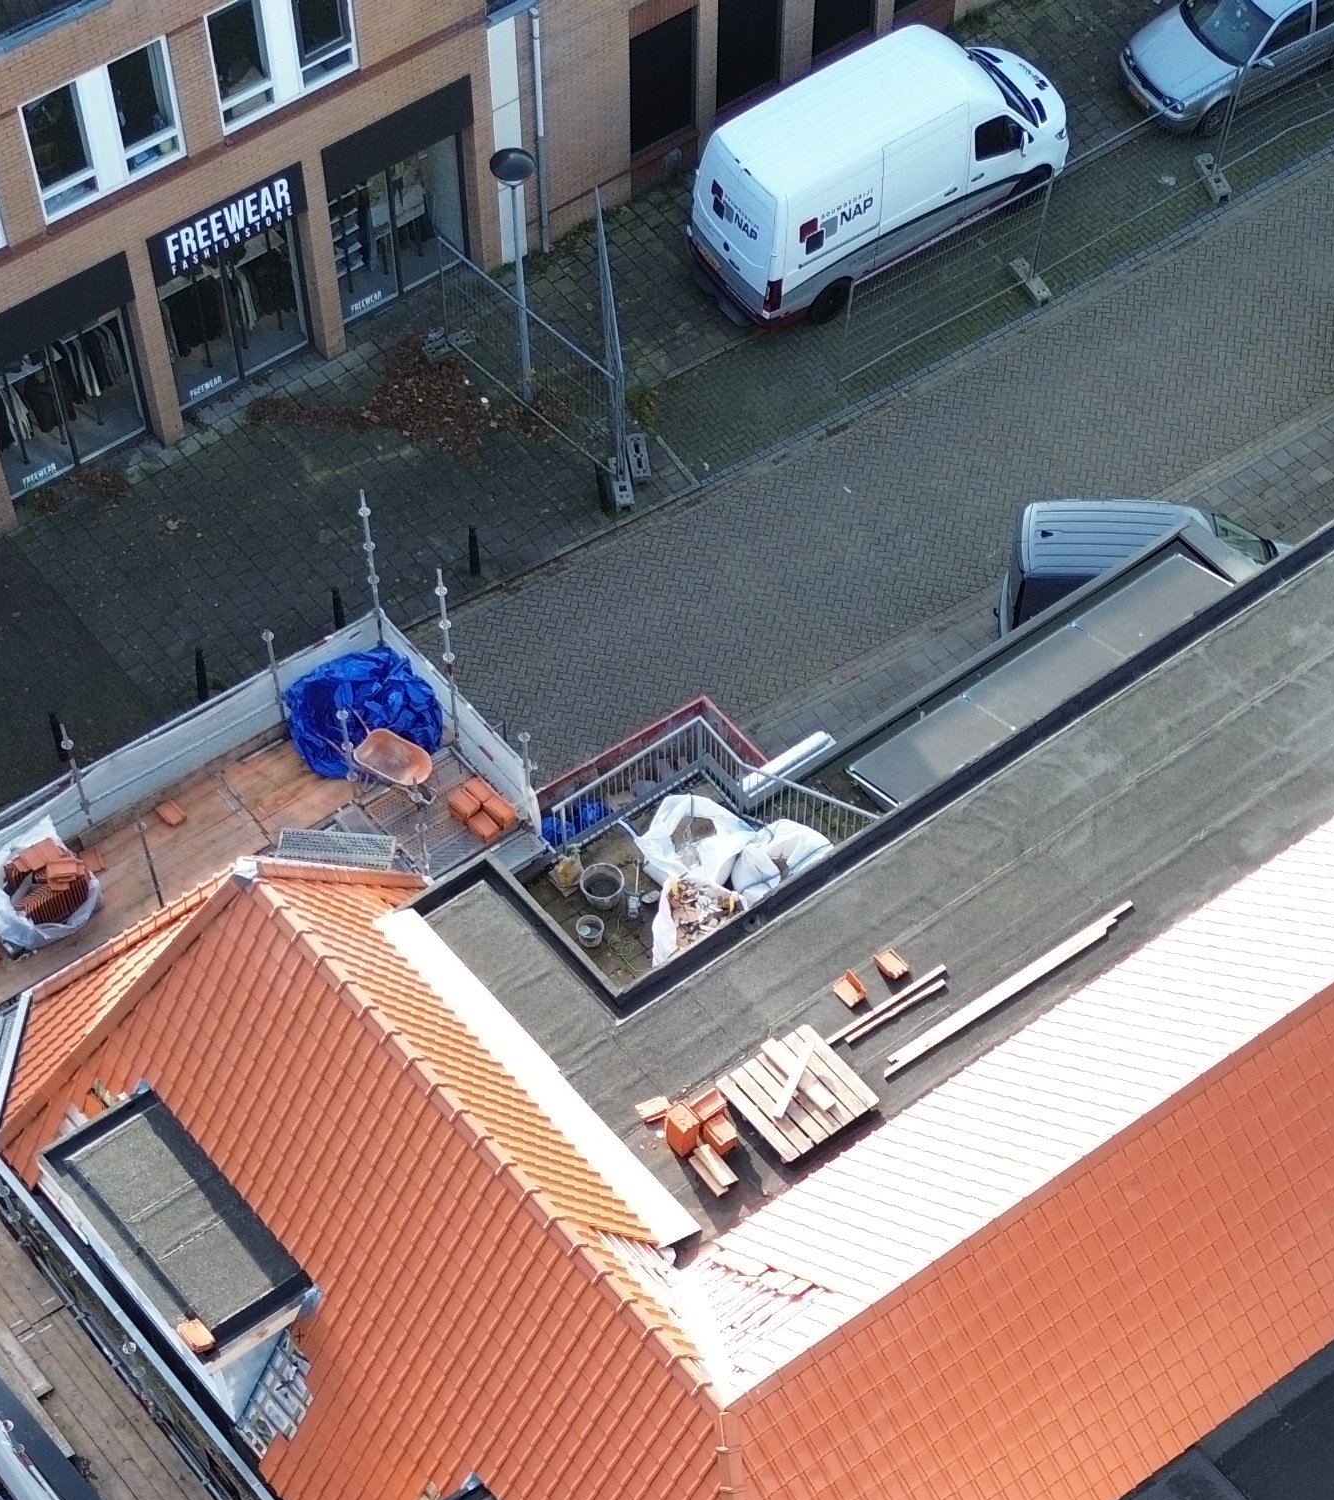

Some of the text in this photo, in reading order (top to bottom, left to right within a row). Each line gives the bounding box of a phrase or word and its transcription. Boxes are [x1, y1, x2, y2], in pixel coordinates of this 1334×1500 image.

[165, 178, 292, 264] FREEWEAR
[733, 212, 758, 241] NAP
[838, 196, 874, 226] NAP
[170, 205, 294, 276] FASHIONSTORE
